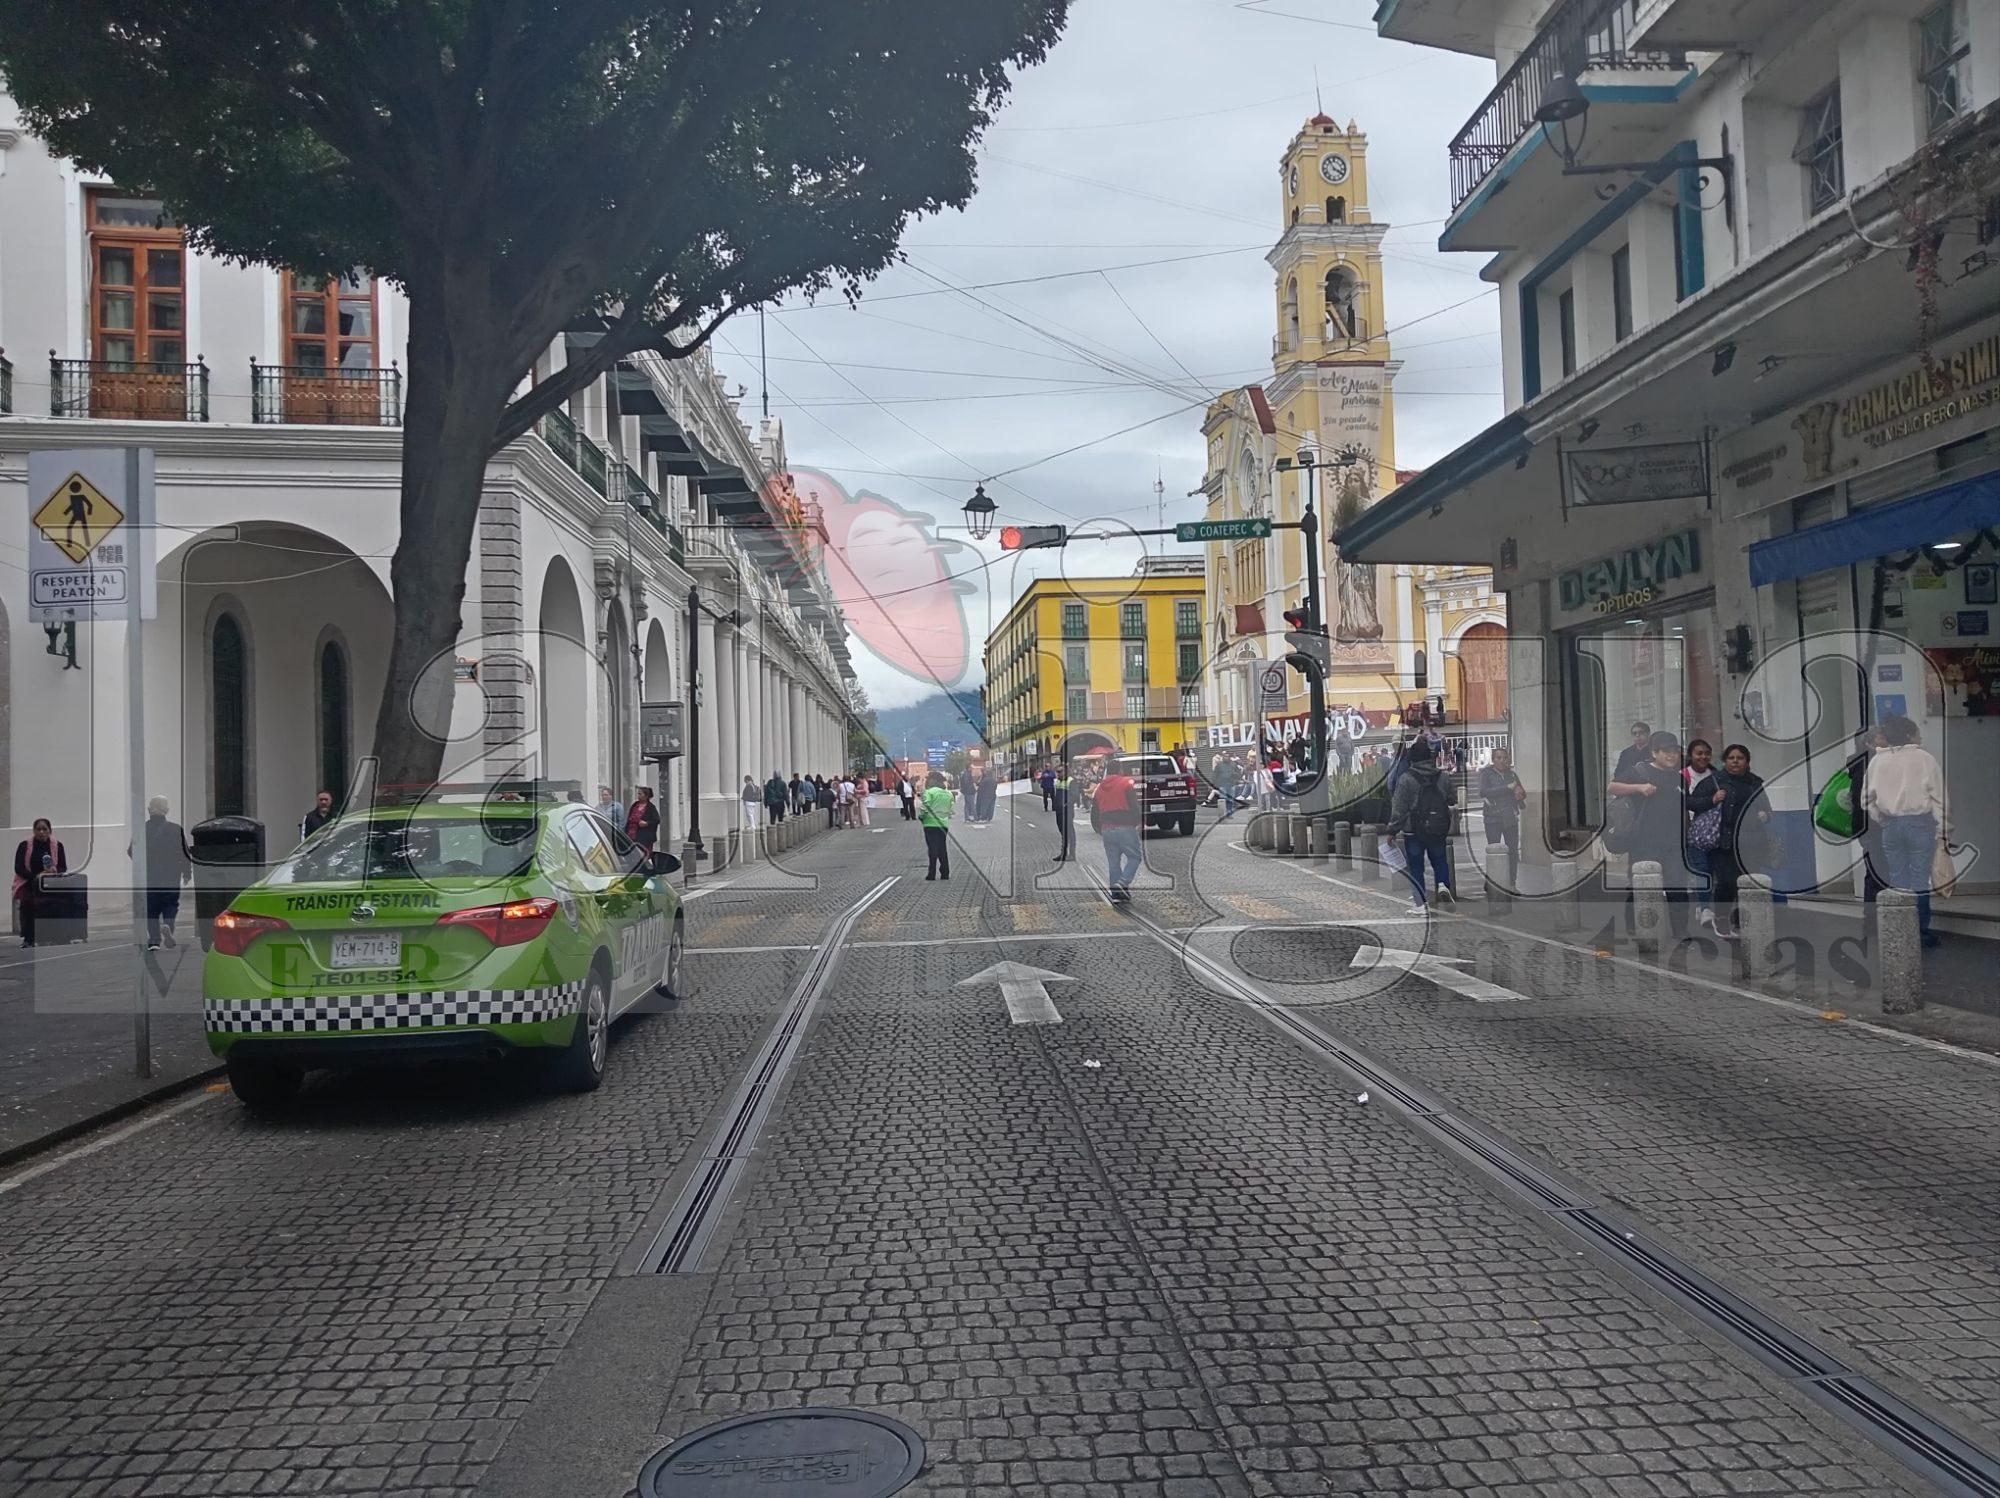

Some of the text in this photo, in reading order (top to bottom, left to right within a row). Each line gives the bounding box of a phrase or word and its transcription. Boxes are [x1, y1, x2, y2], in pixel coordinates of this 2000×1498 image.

[1320, 371, 1347, 388] Ave
[1840, 359, 1947, 438] FARMACIAS
[1923, 402, 1956, 428] PERO
[1200, 523, 1247, 537] COATEPEC
[1558, 527, 1702, 612] DEVLYN
[42, 574, 118, 587] RESPETE AL
[1209, 721, 1257, 748] FELIZ
[370, 893, 442, 909] ESTATAL
[312, 969, 417, 986] TE01-554
